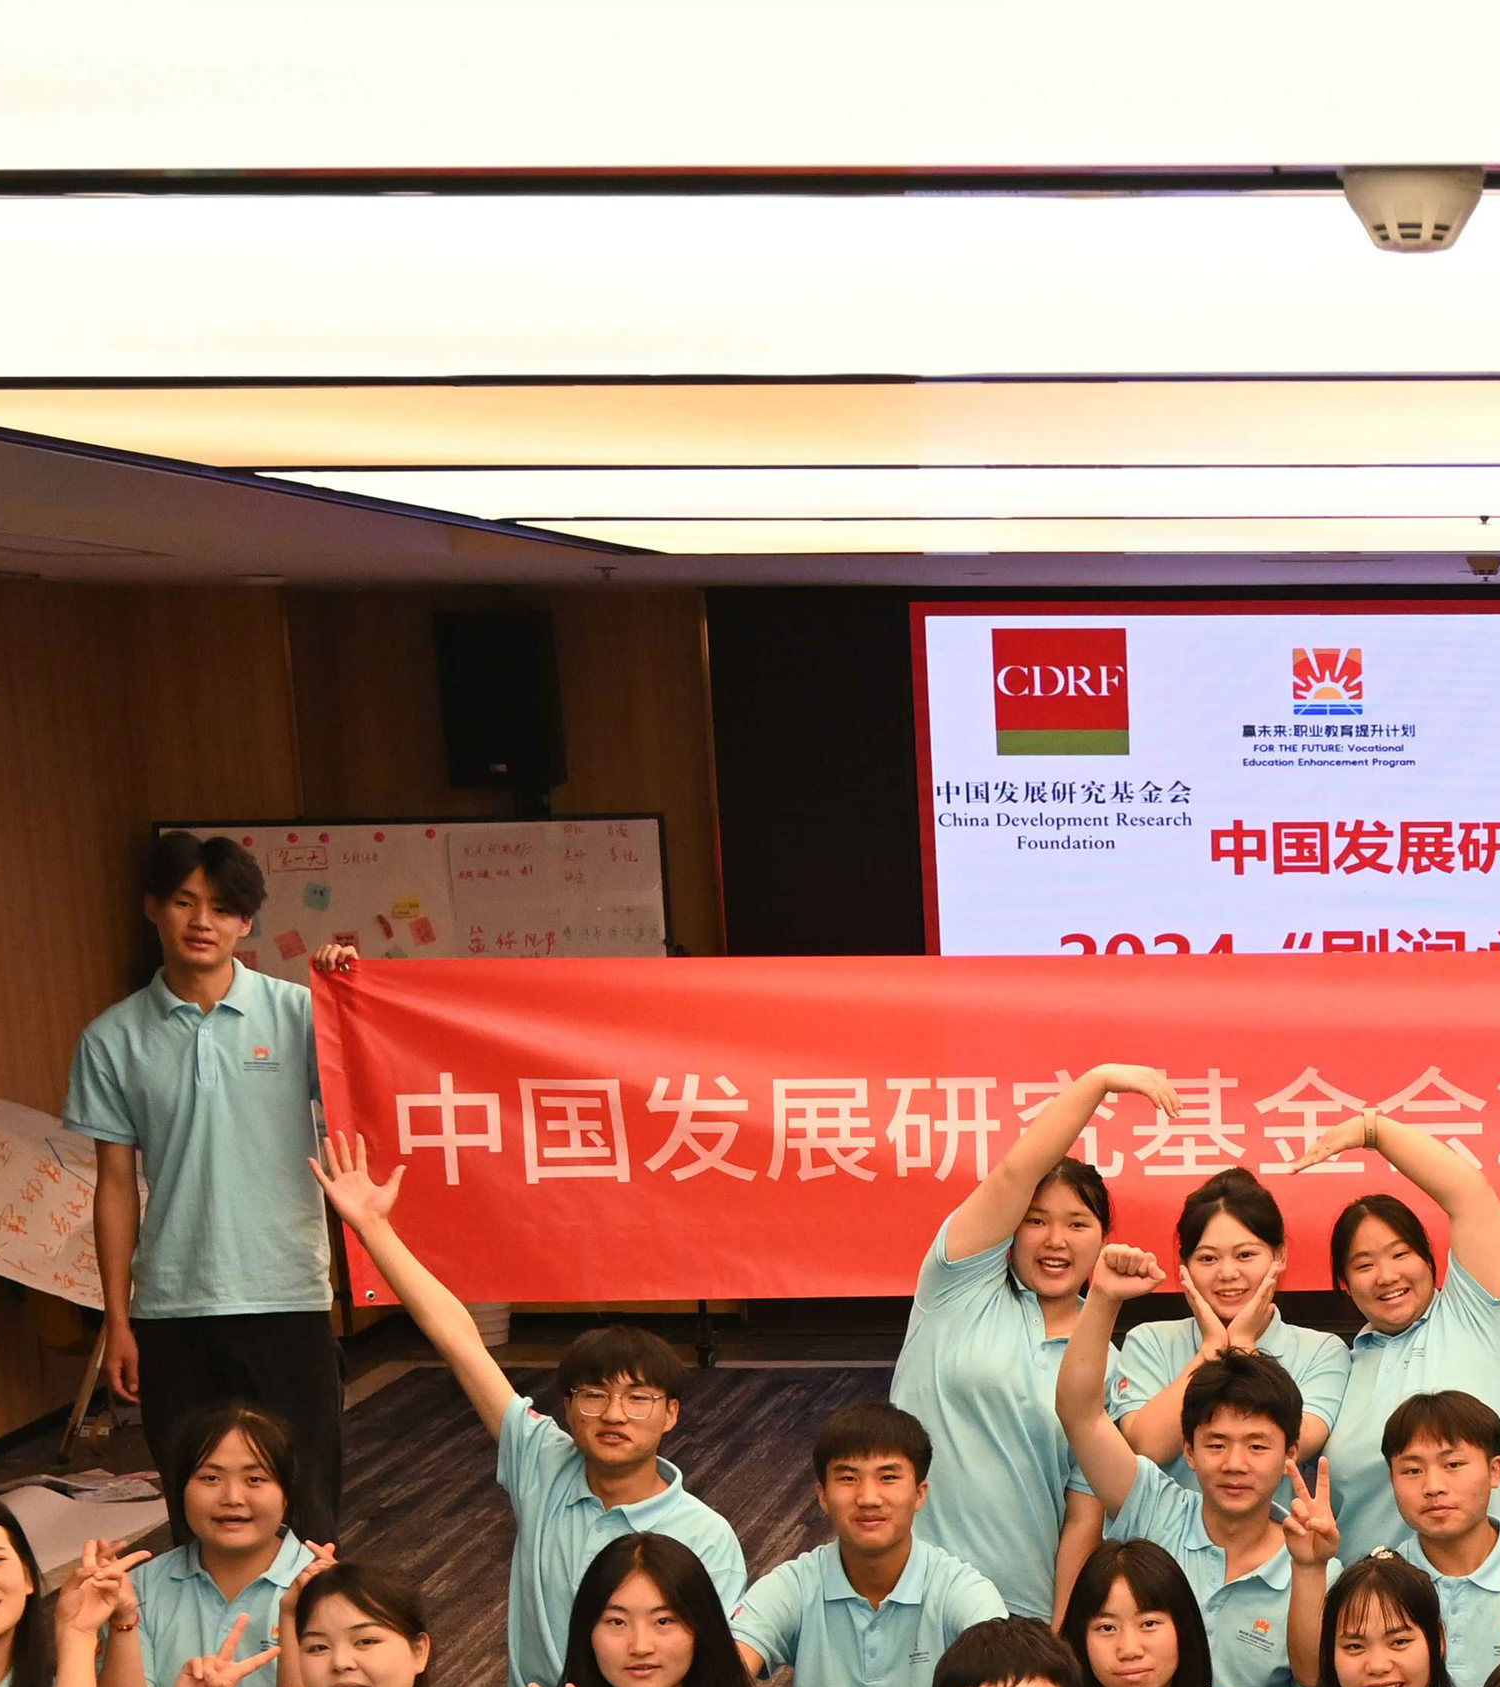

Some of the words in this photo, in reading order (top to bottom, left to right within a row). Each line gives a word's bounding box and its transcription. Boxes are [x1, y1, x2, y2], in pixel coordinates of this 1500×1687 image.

[996, 665, 1125, 697] CDRF
[1253, 744, 1275, 753] FOR
[1279, 744, 1297, 753] THE
[1301, 744, 1344, 753] FUTURE:
[1347, 743, 1404, 753] Vocational
[1242, 758, 1295, 767] Education
[1298, 758, 1369, 767] Enhancement
[1372, 758, 1416, 768] Program
[936, 780, 1192, 804] 中国发展研究基金会
[938, 813, 990, 828] China
[996, 812, 1109, 831] Development
[1116, 811, 1192, 827] Research
[1017, 835, 1116, 850] Foundation
